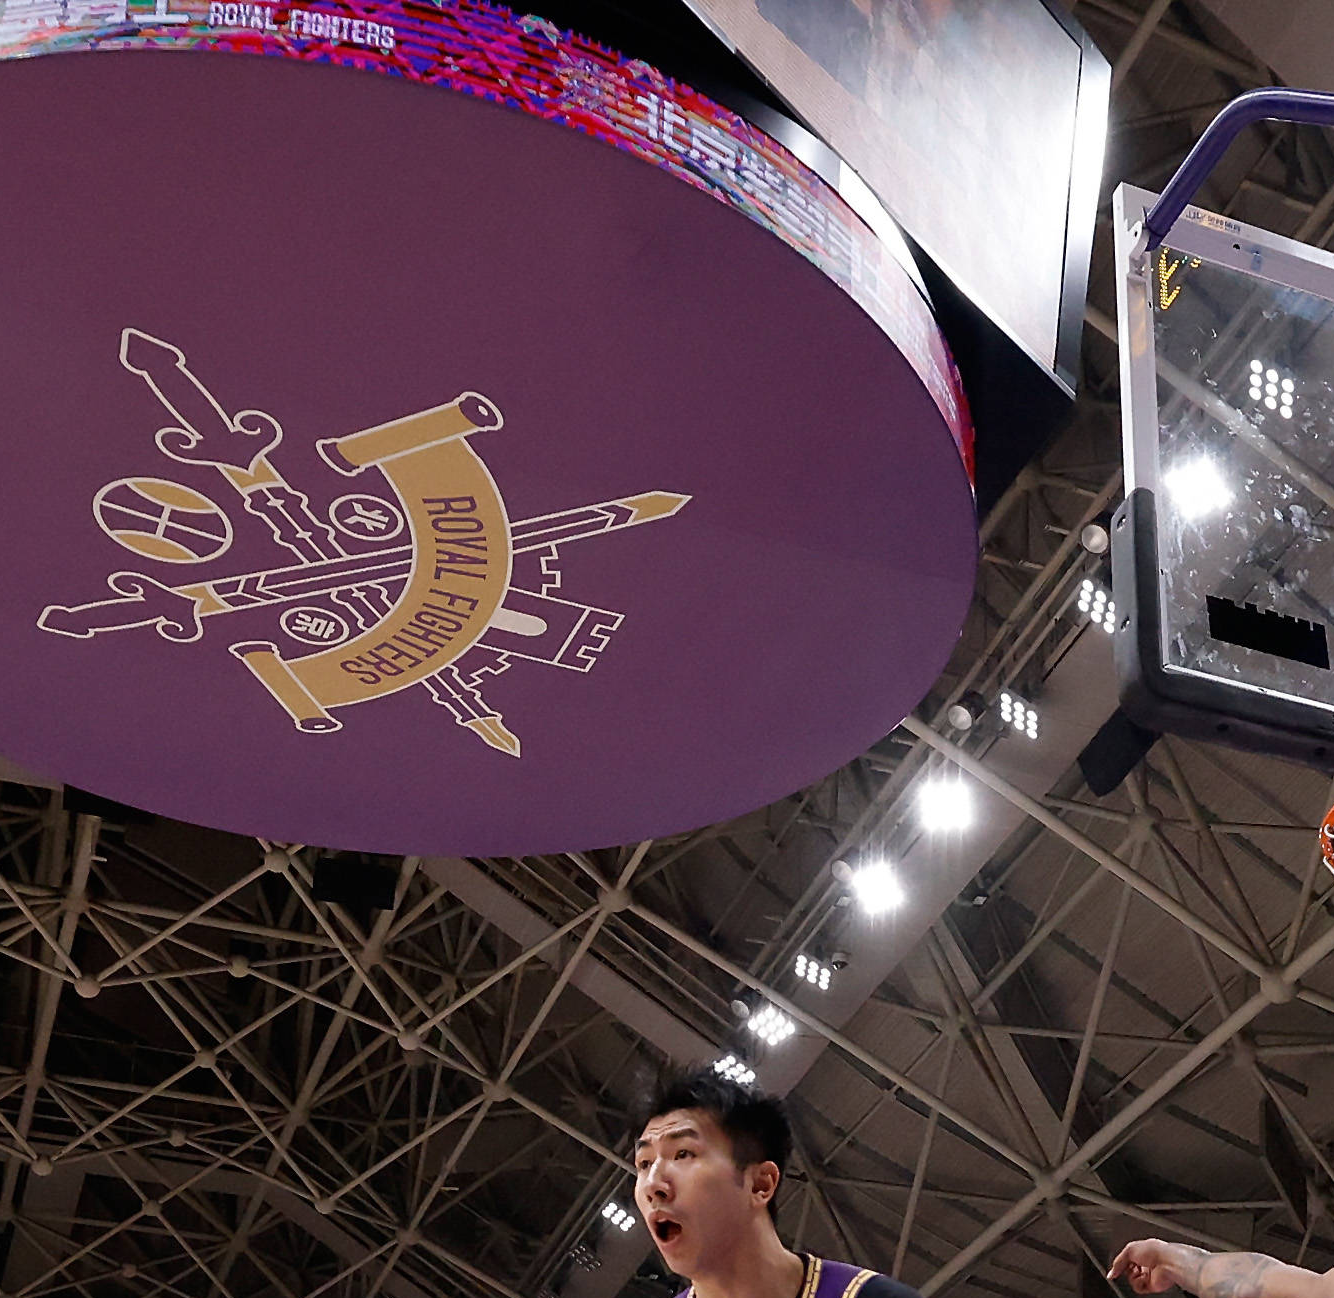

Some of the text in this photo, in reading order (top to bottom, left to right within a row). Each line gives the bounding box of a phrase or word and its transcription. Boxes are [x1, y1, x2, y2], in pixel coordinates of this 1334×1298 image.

[209, 1, 396, 49] ROYAL FIGHTERS
[340, 495, 488, 684] ROYAL FIGHTERS
